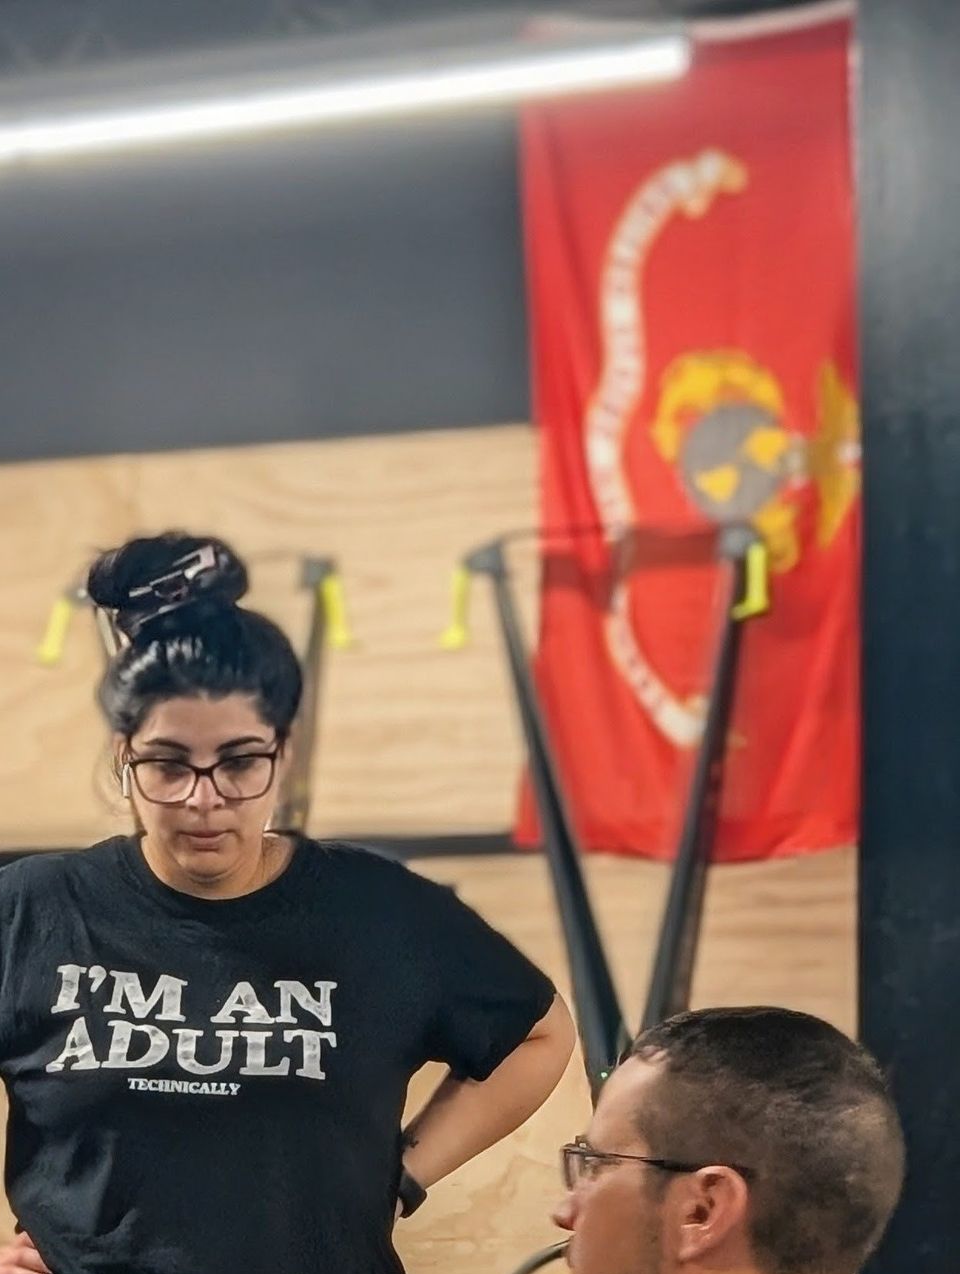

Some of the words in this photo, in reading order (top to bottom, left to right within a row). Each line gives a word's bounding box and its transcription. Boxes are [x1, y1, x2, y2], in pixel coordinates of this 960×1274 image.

[50, 963, 188, 1022] I'M
[210, 980, 338, 1026] AN
[45, 1016, 337, 1080] ADULT
[127, 1077, 241, 1096] TECHNICALLY
